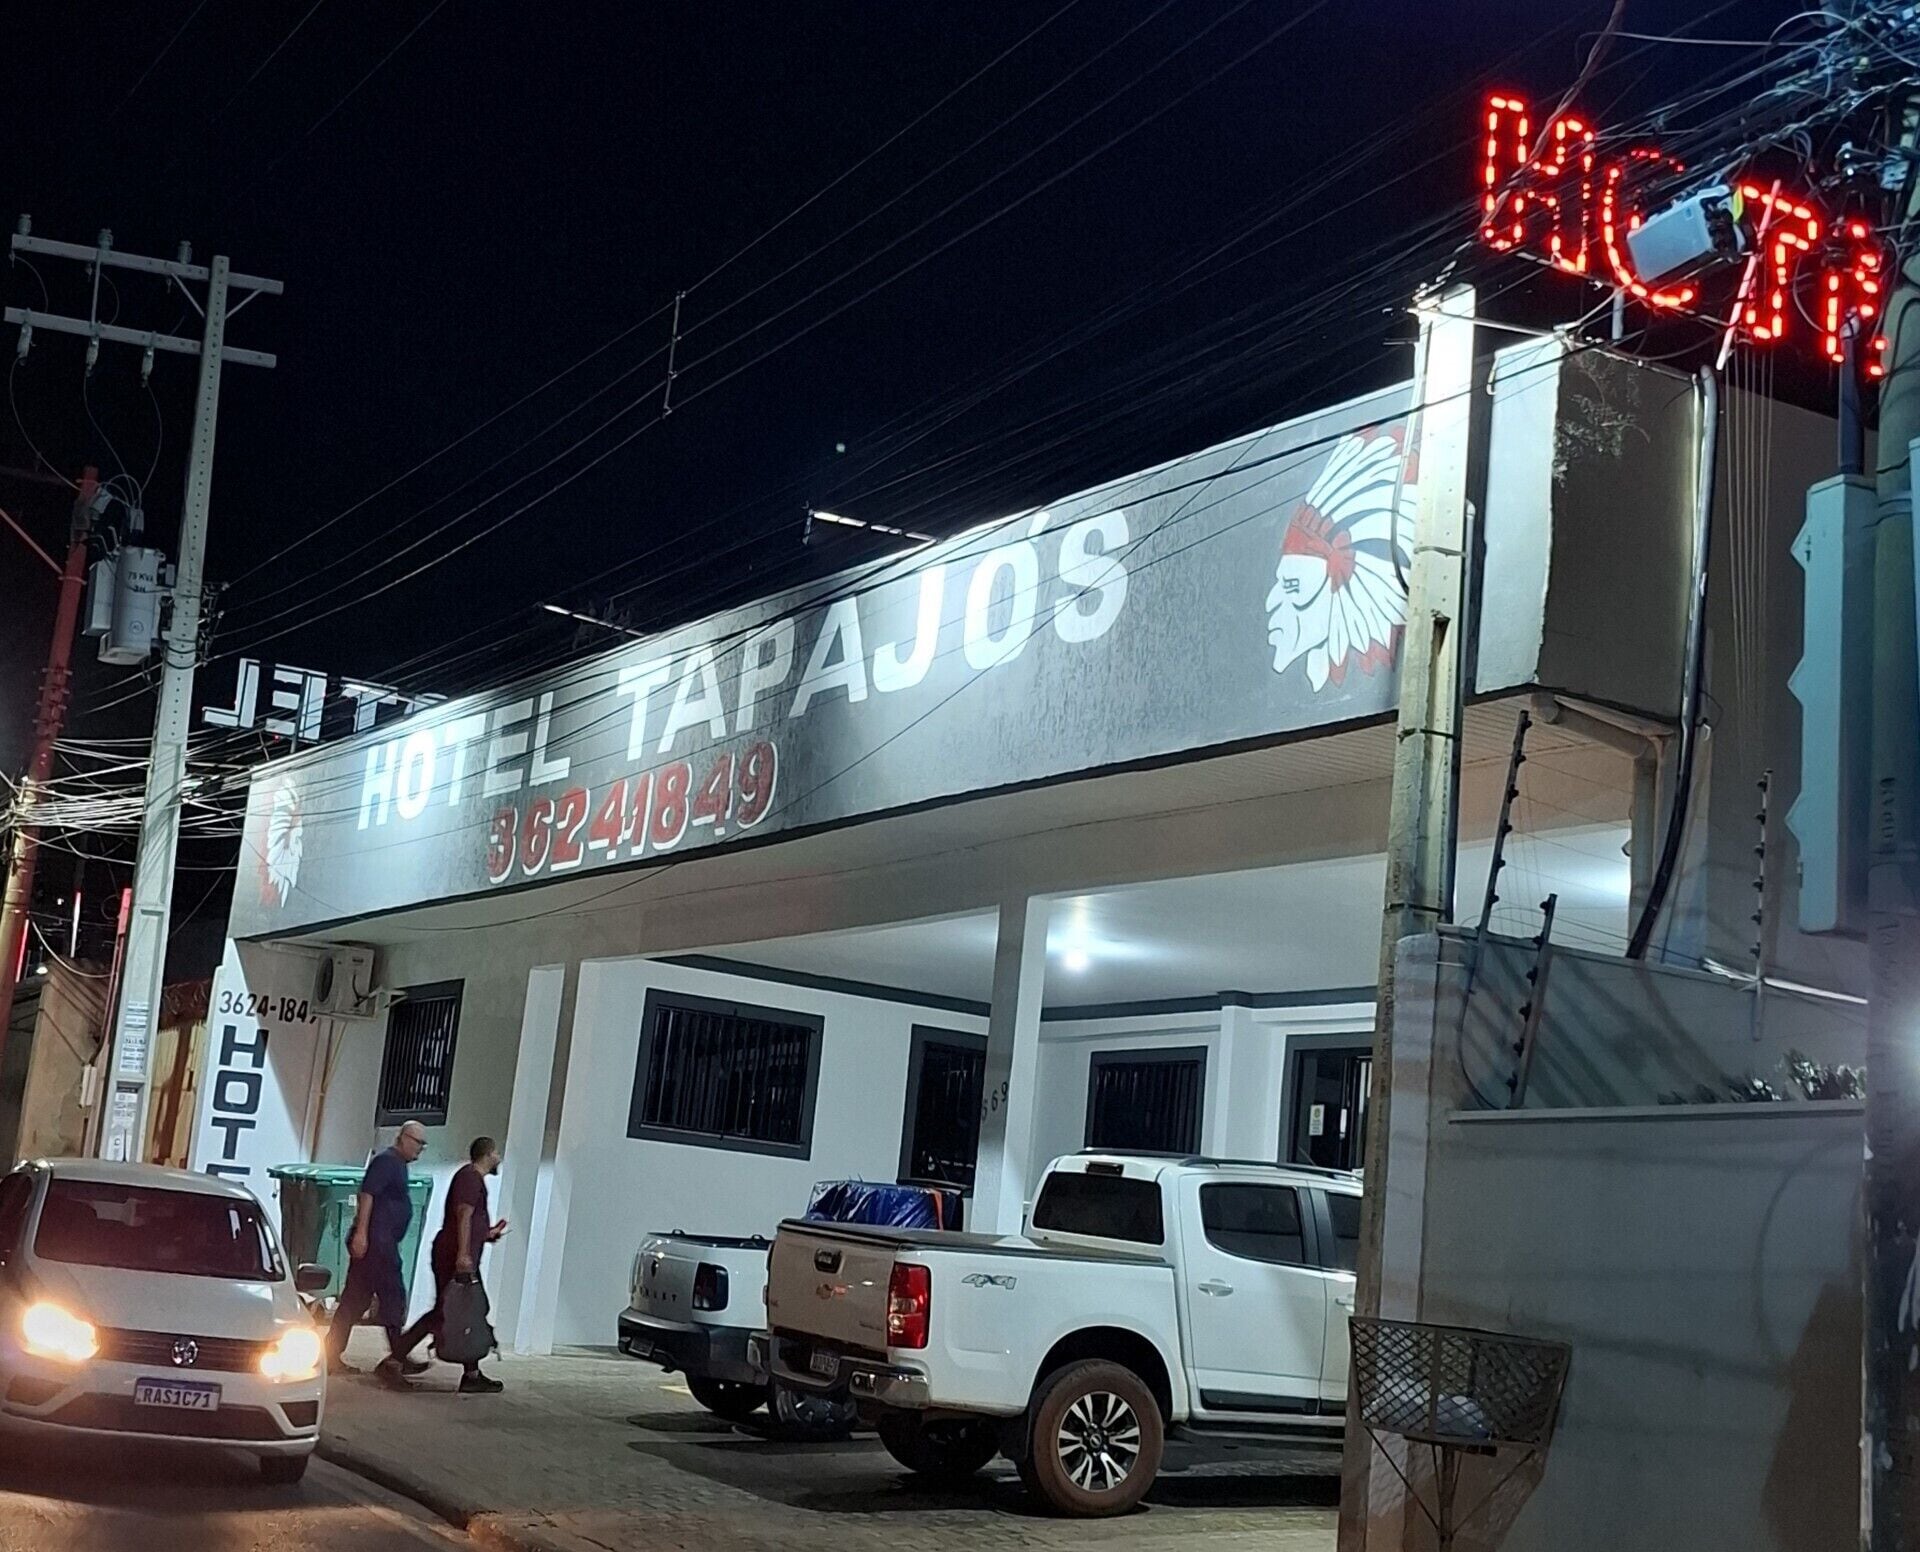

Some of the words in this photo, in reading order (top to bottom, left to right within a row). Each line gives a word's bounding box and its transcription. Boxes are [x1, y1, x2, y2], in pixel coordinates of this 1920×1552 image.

[357, 691, 571, 831] HOTEL
[487, 741, 778, 884] 36241849
[219, 990, 317, 1025] 3624-184
[143, 1387, 211, 1408] RAS1C71
